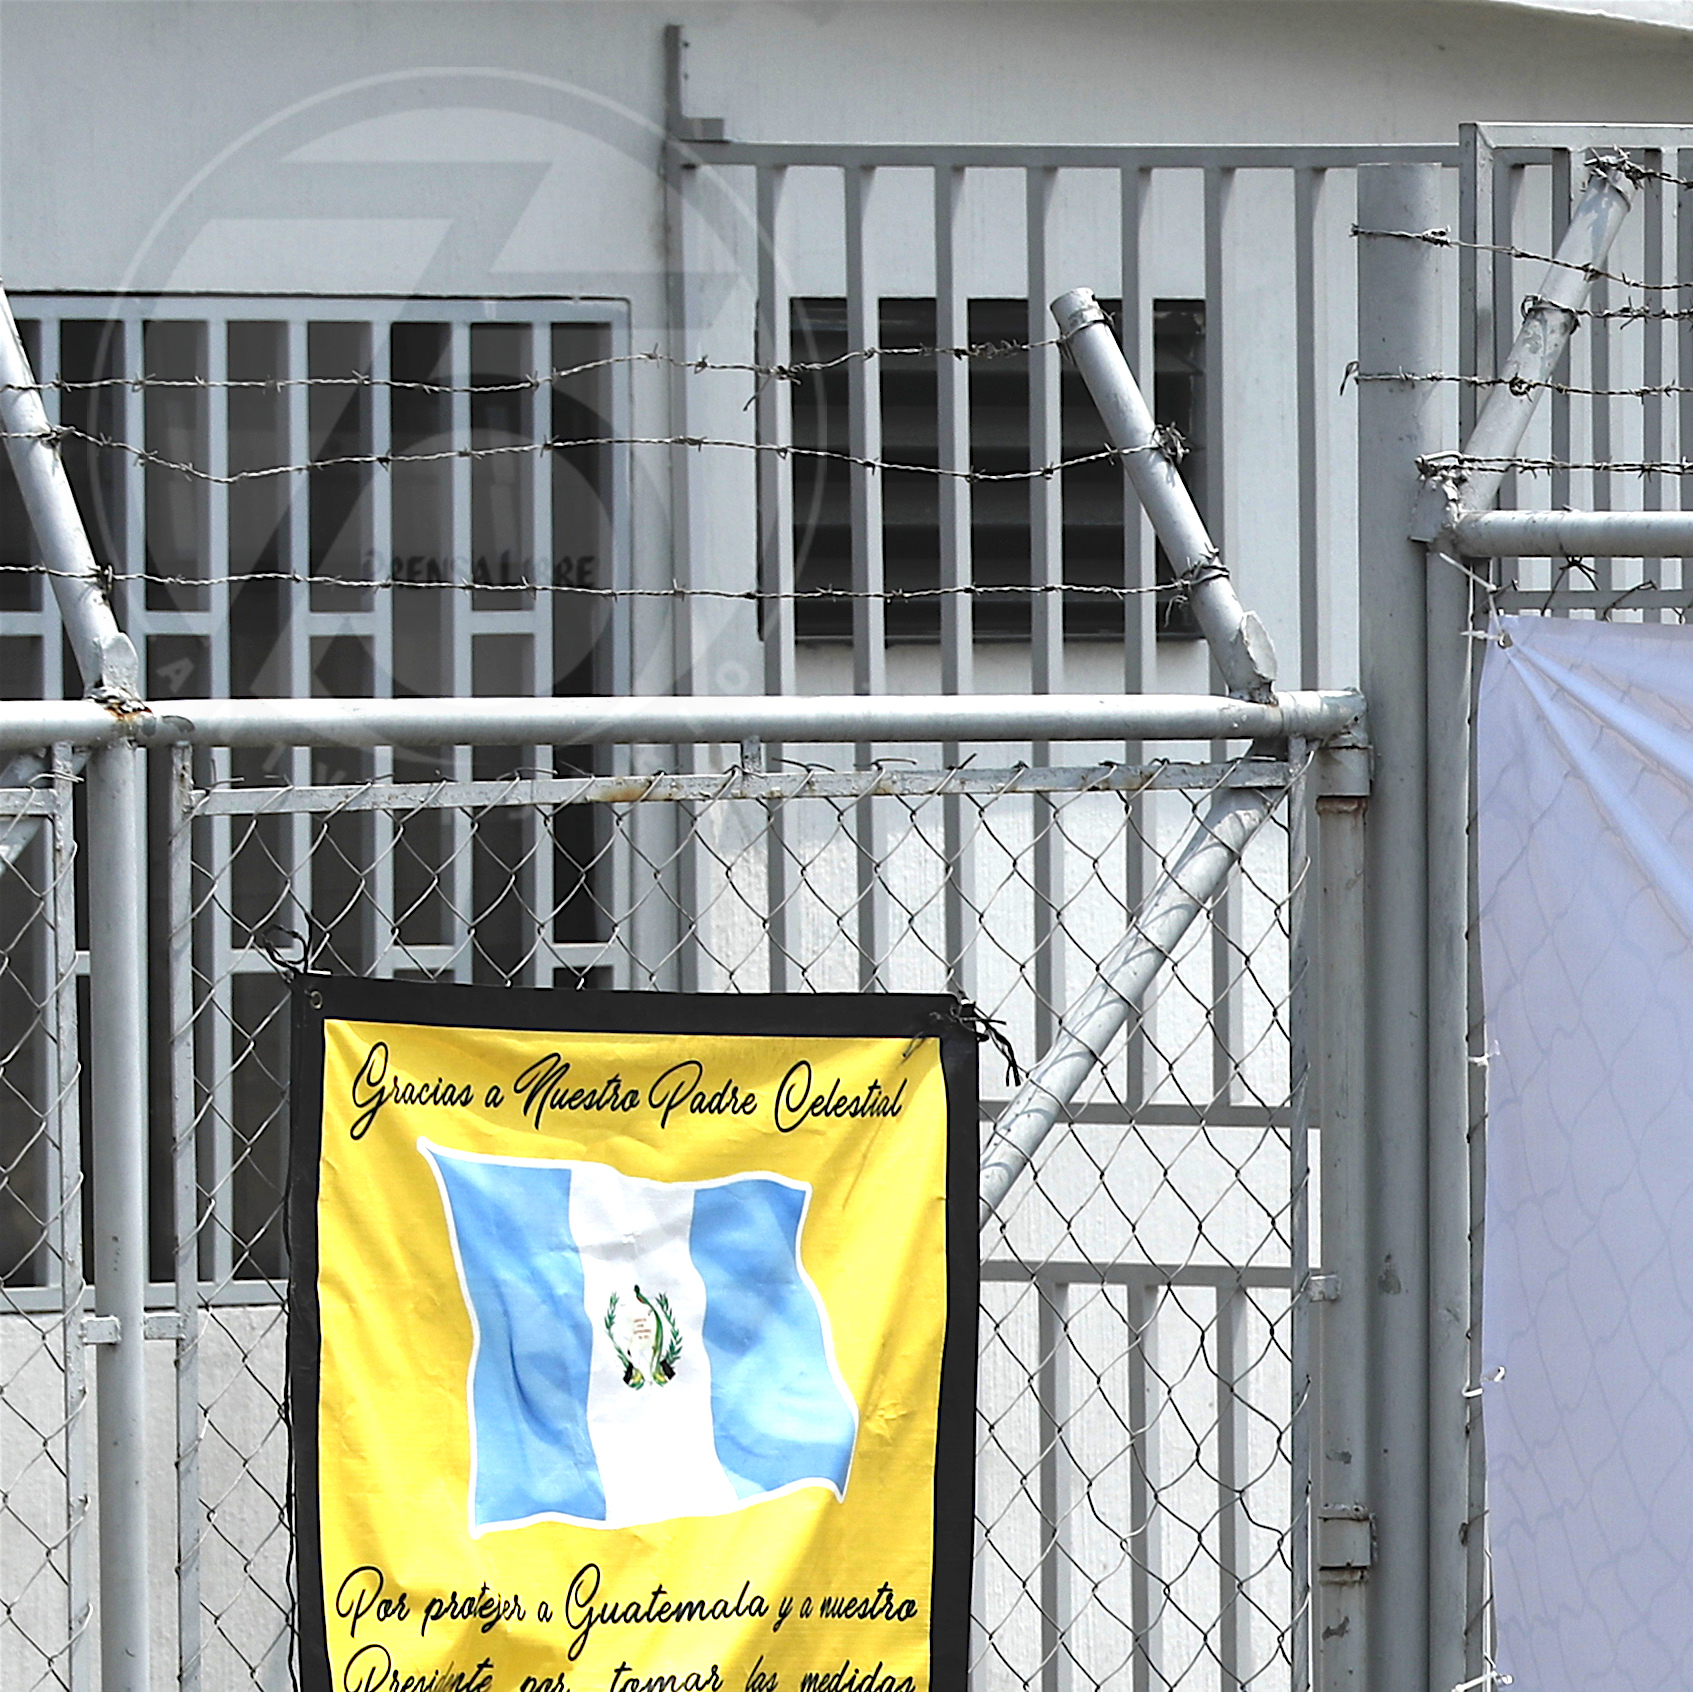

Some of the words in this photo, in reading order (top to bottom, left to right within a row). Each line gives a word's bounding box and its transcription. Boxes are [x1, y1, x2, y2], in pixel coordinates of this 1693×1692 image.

[350, 1041, 474, 1140] Gracias
[485, 1084, 505, 1108] a
[513, 1052, 640, 1130] Nuestro
[649, 1060, 757, 1130] Padre
[775, 1060, 909, 1133] Celestial
[336, 1565, 411, 1638] Por
[537, 1600, 553, 1623] a
[565, 1563, 770, 1661] Guatemala
[772, 1596, 793, 1633] y
[799, 1596, 813, 1619] a
[819, 1581, 918, 1622] nuestro
